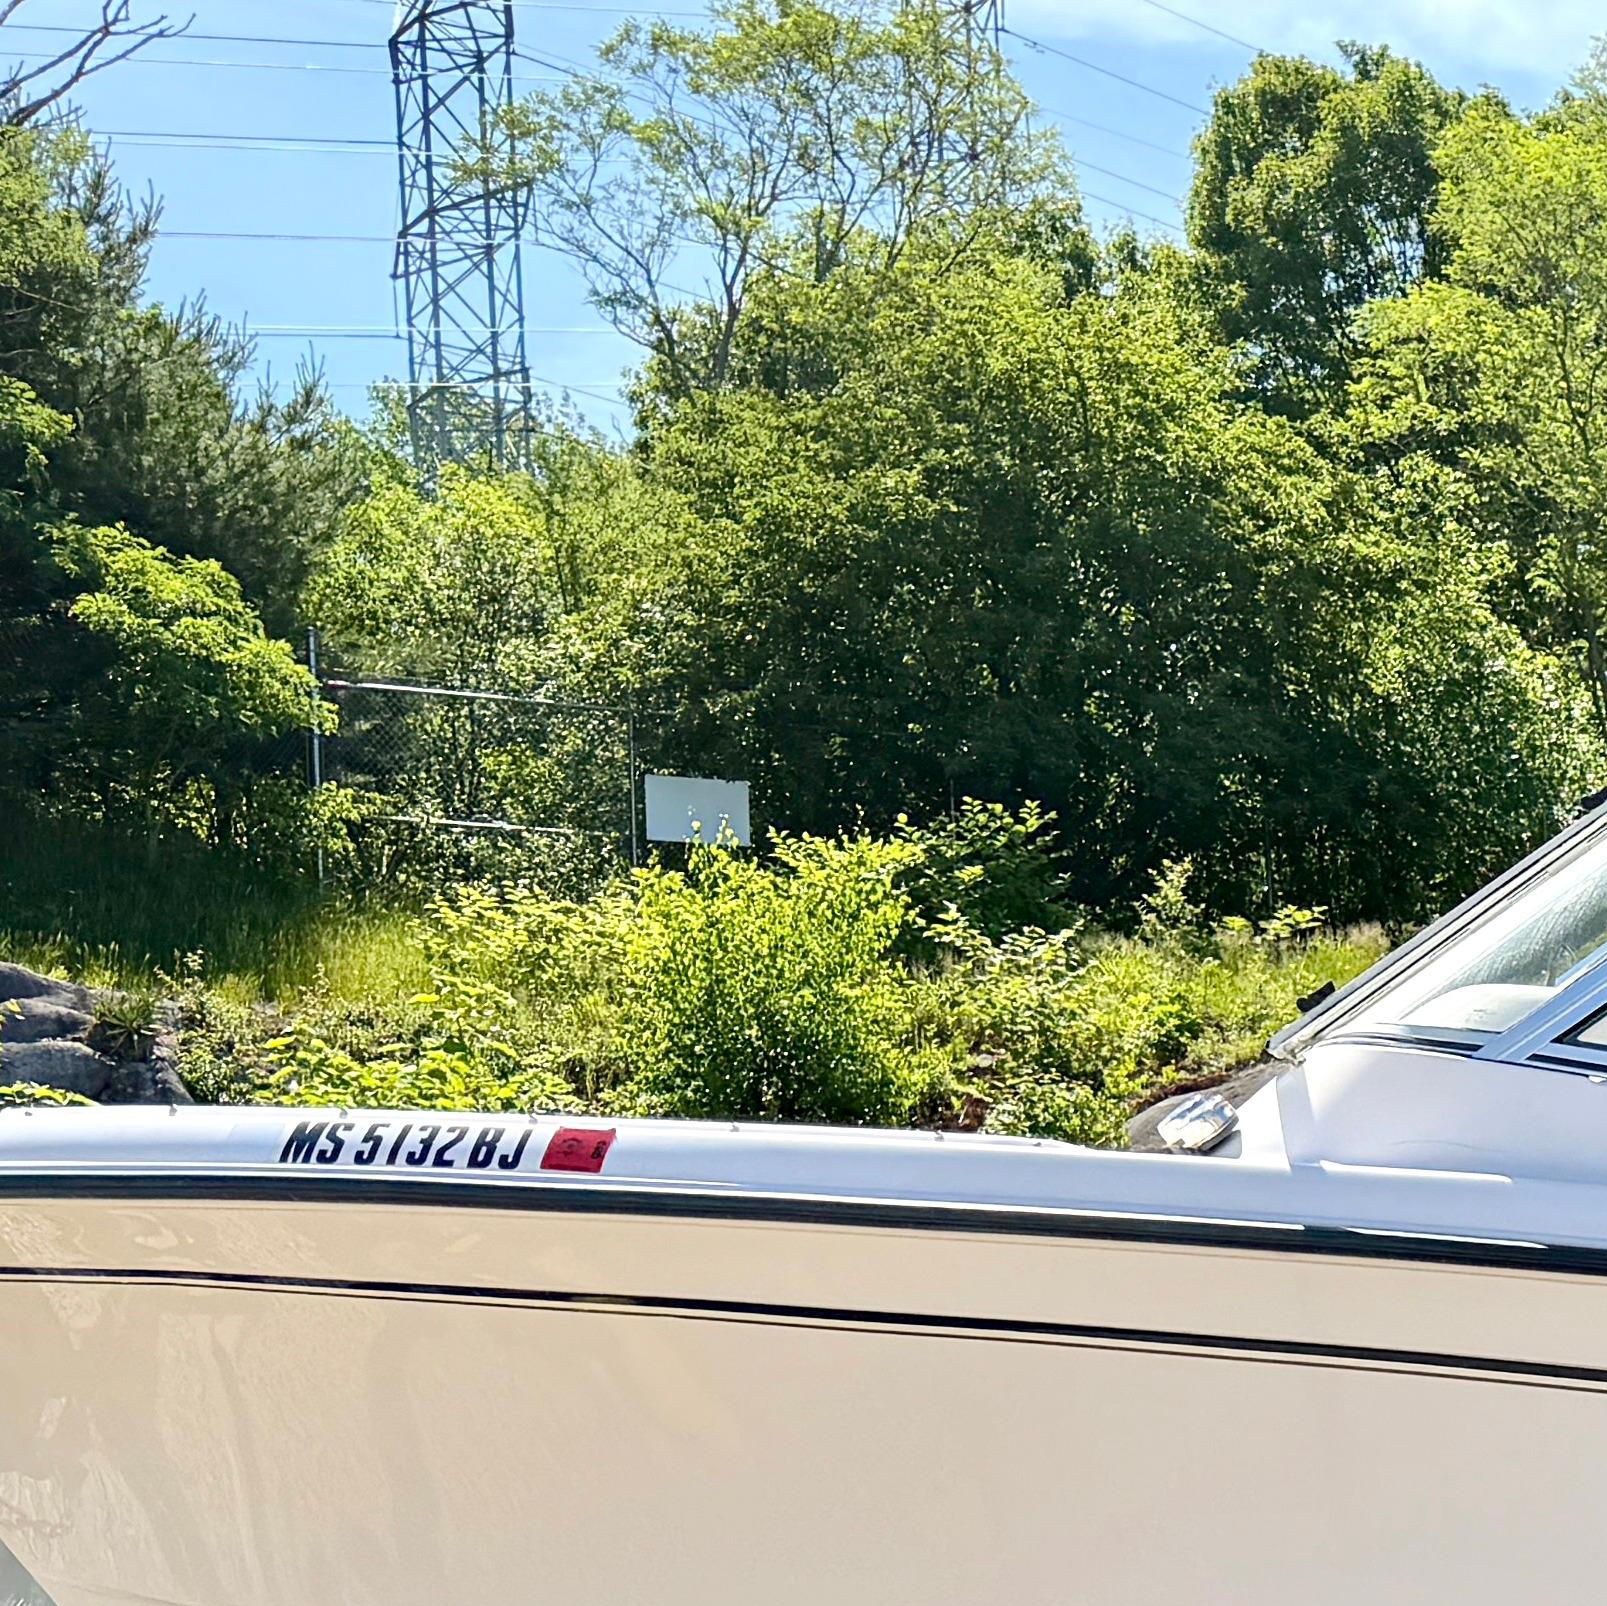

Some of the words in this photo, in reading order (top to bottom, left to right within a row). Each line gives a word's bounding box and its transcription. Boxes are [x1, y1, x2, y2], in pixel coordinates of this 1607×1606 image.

[279, 1121, 355, 1164] MS
[354, 1122, 465, 1168] 5132
[466, 1126, 533, 1170] BJ
